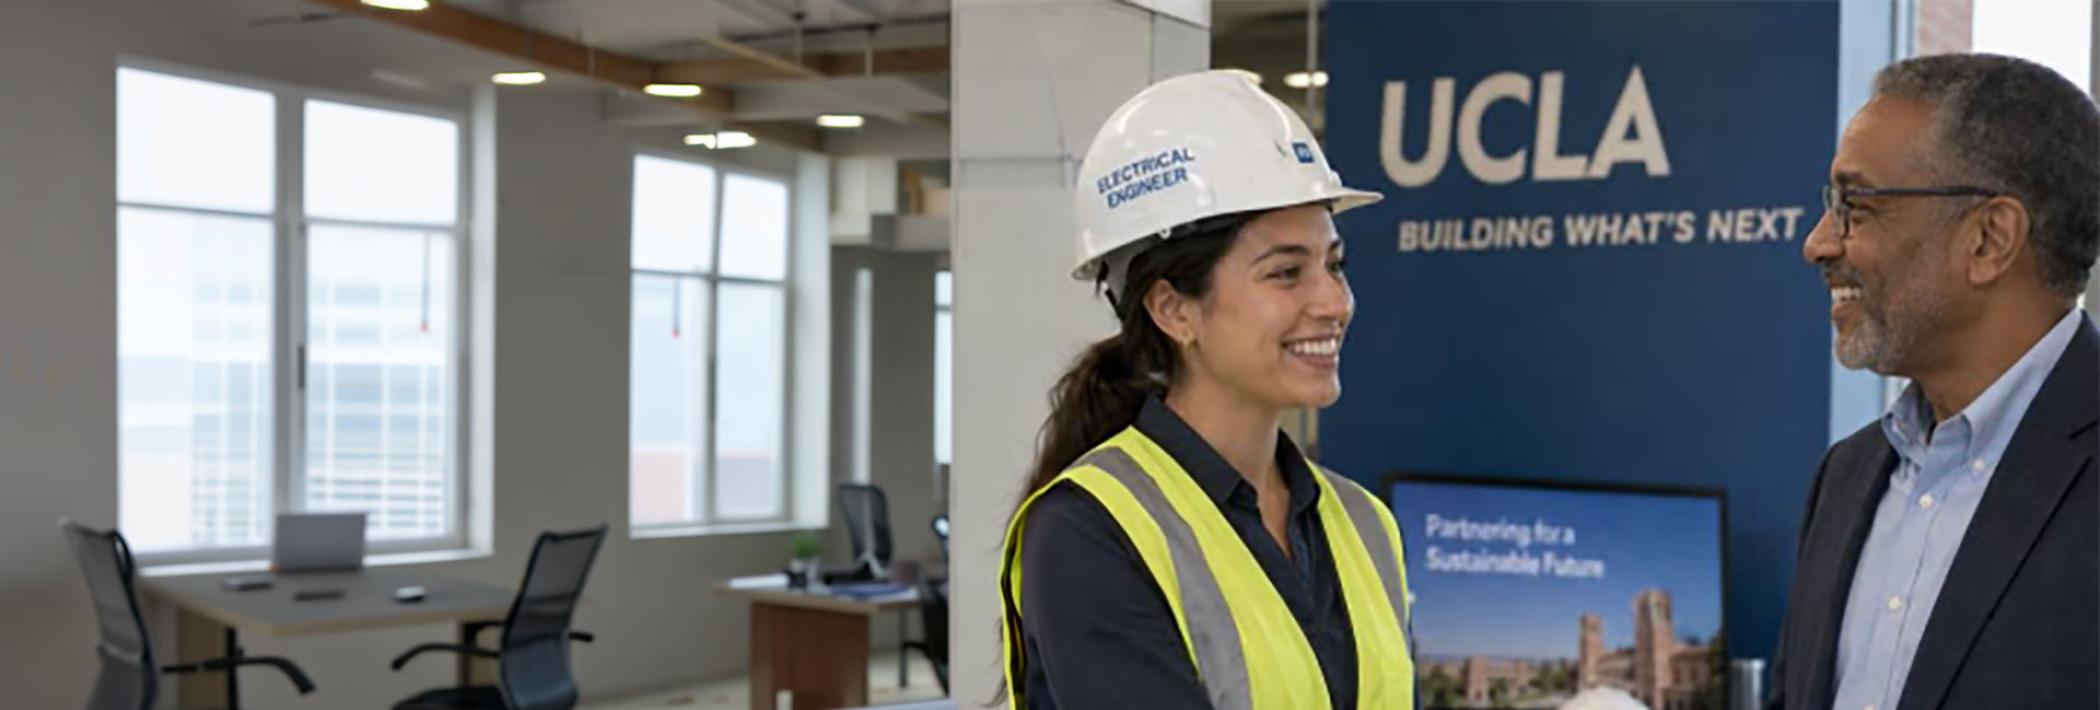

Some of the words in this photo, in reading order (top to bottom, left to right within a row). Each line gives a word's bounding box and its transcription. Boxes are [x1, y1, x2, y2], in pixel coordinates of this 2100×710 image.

[1379, 64, 1671, 187] UCLA
[1097, 148, 1195, 194] ELECTRICAL
[1107, 167, 1188, 208] ENGINEER
[1399, 215, 1554, 251] BUILDING
[1564, 210, 1696, 246] WHAT'S
[1706, 207, 1804, 241] NEXT
[1425, 513, 1532, 547] Partnering
[1534, 517, 1561, 544] for
[1562, 527, 1576, 545] a
[1426, 545, 1539, 574] Sustainable
[1544, 553, 1605, 578] Future
